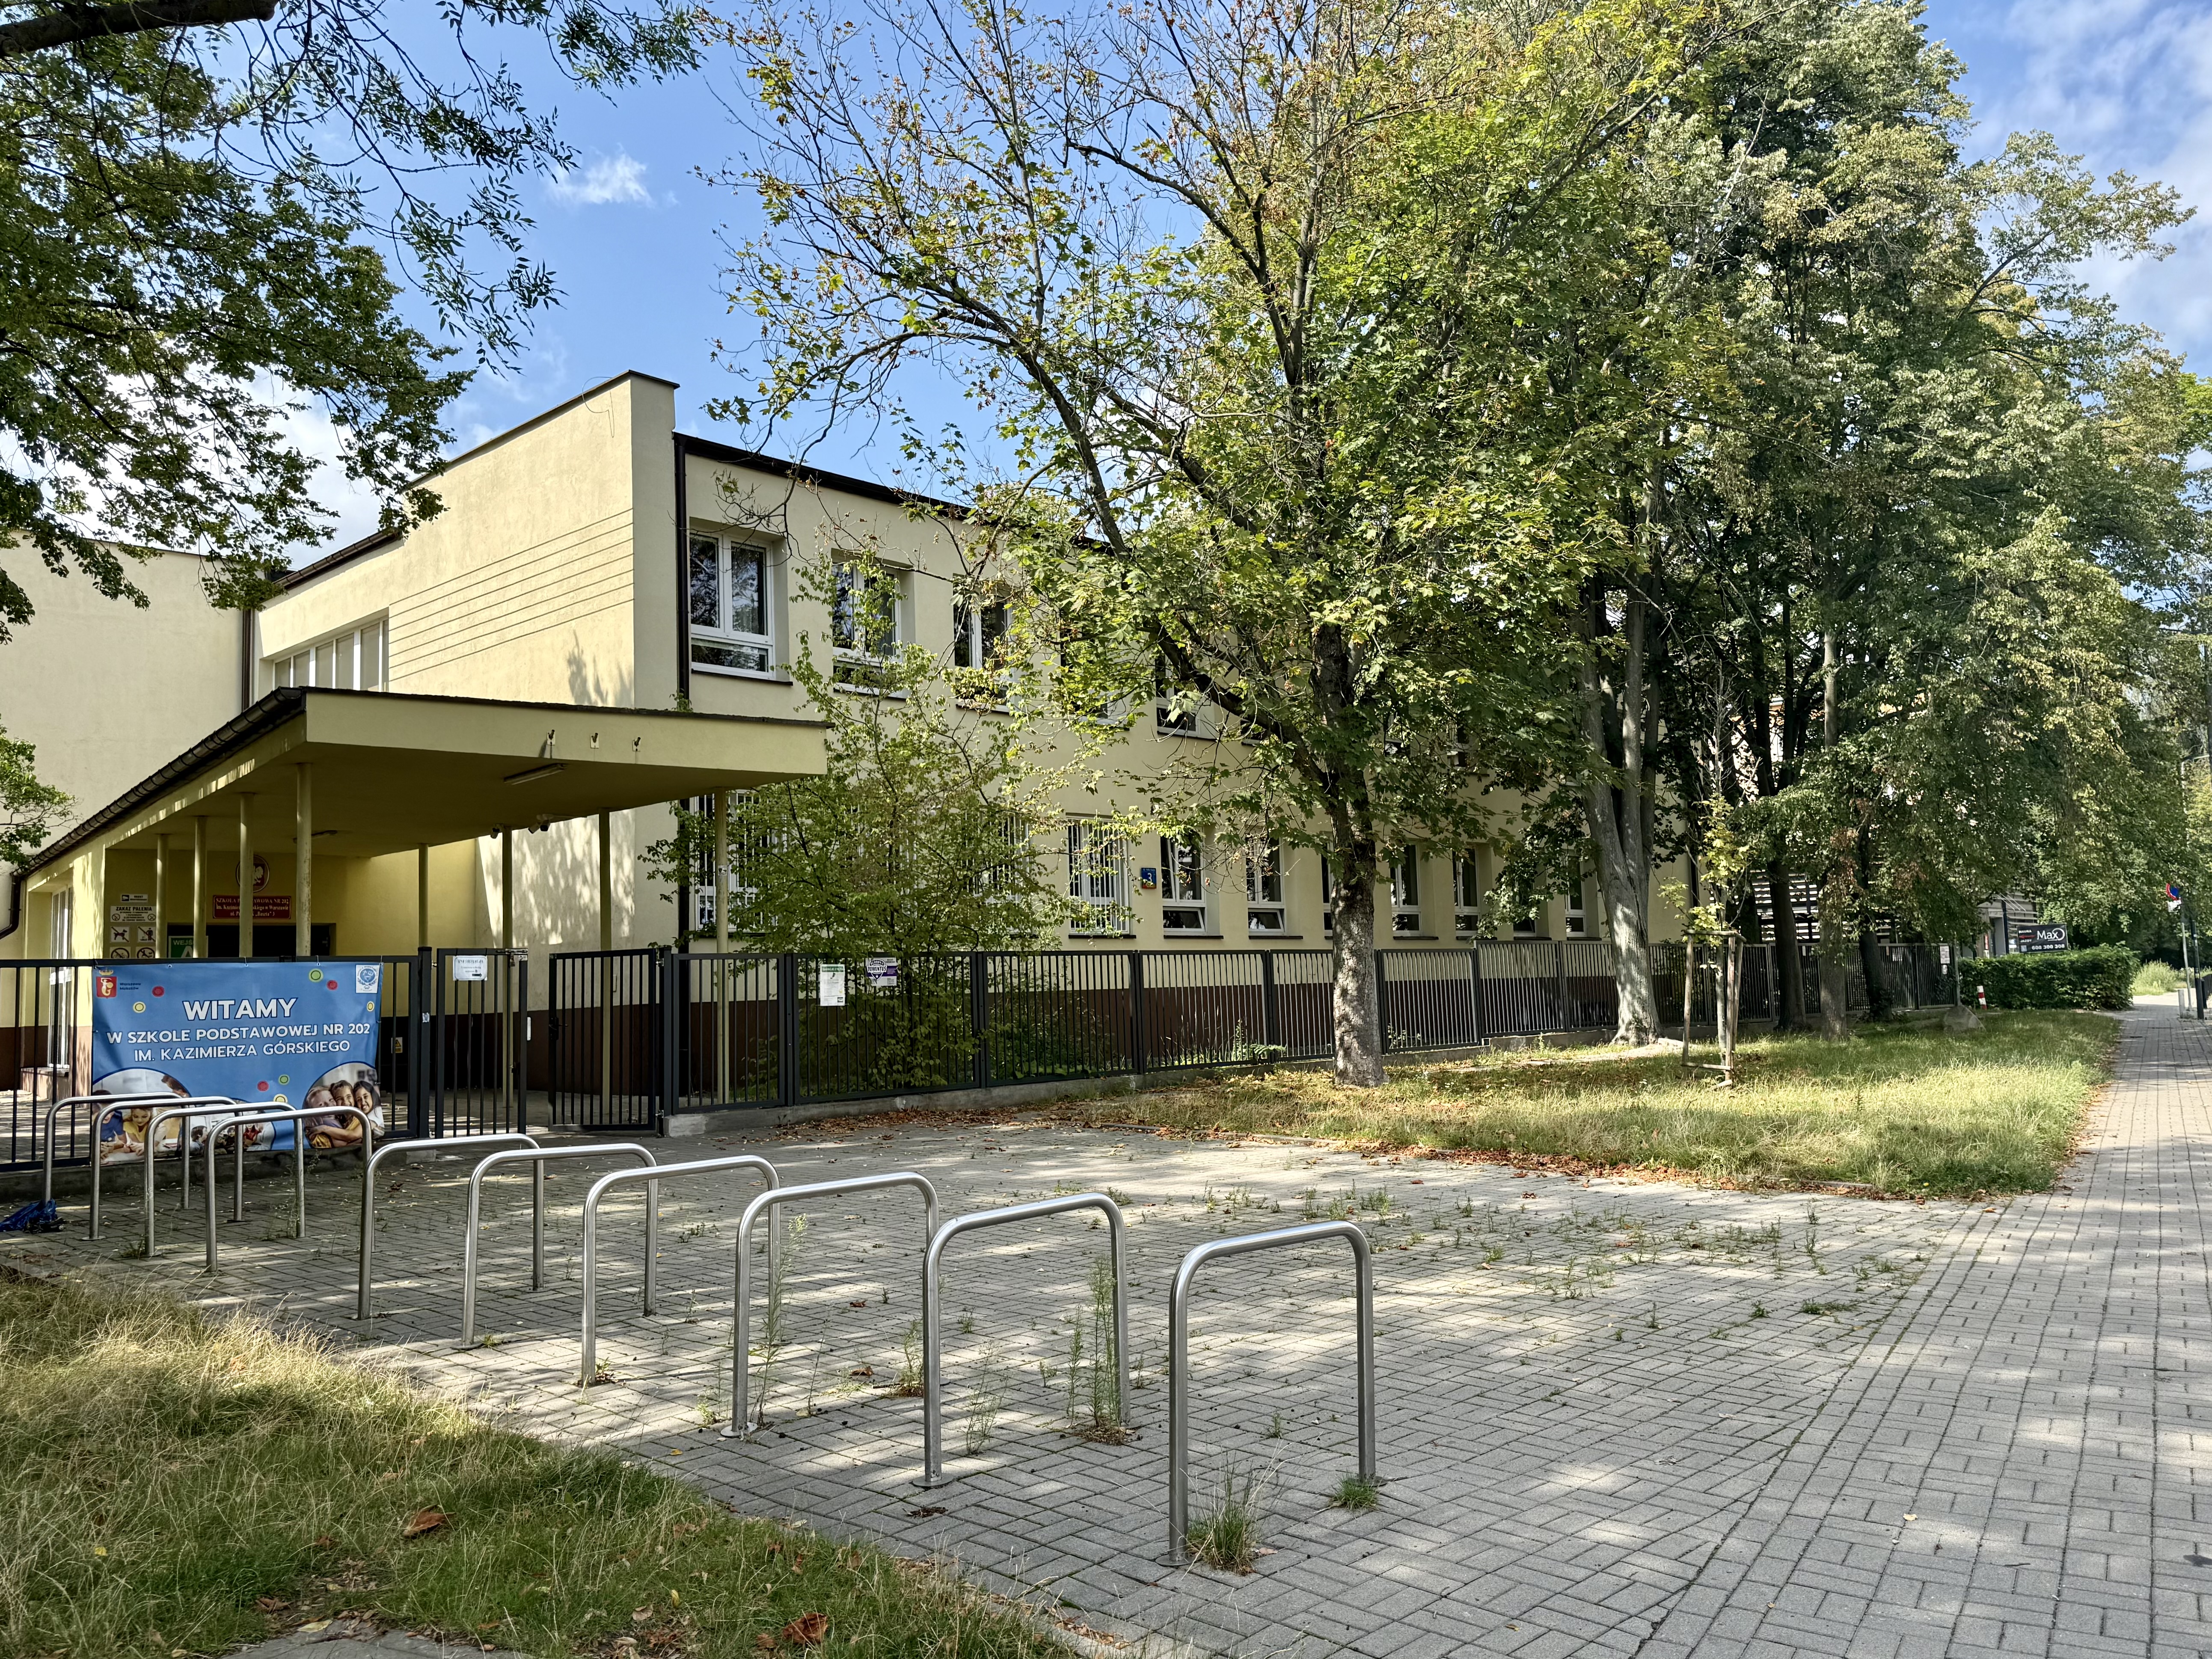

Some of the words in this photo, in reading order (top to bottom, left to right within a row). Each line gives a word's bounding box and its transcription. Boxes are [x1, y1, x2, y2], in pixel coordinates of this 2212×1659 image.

[1147, 873, 1152, 883] 3
[2037, 930, 2059, 940] Max
[183, 997, 298, 1021] WITAMY
[107, 1032, 122, 1044] W
[128, 1030, 190, 1043] SZKOLE
[196, 1024, 318, 1041] PODSTAWOWEJ
[323, 1024, 344, 1035] NR
[348, 1023, 370, 1034] 202
[134, 1049, 155, 1062] IM.
[161, 1044, 258, 1060] KAZIMIERZA
[263, 1040, 350, 1055] GÓRSKIEGO
